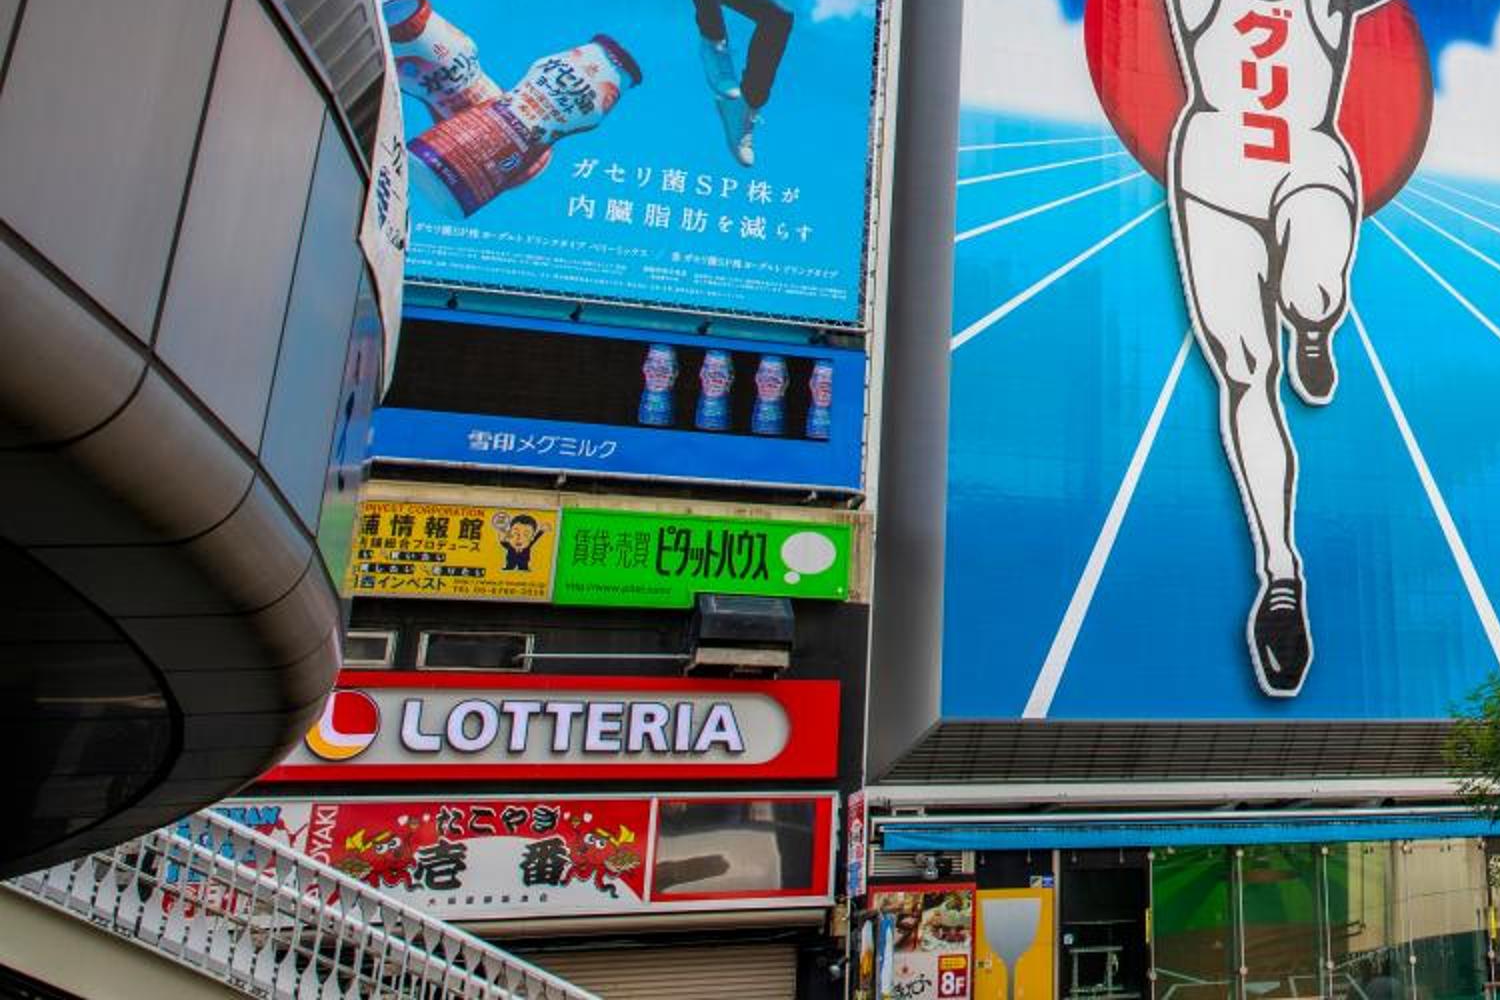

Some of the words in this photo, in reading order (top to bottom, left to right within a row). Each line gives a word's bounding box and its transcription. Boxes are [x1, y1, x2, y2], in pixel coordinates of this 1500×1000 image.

[1233, 6, 1294, 165] グリコ
[572, 156, 801, 207] ガセリ菌SP株が
[566, 193, 815, 243] 内臓脂肪を減らす
[465, 429, 619, 460] 雪印メグミルク
[654, 524, 769, 581] ピタットハウス
[398, 699, 746, 754] LOTTERIA
[435, 804, 561, 835] たこやき
[940, 971, 966, 998] 8F
